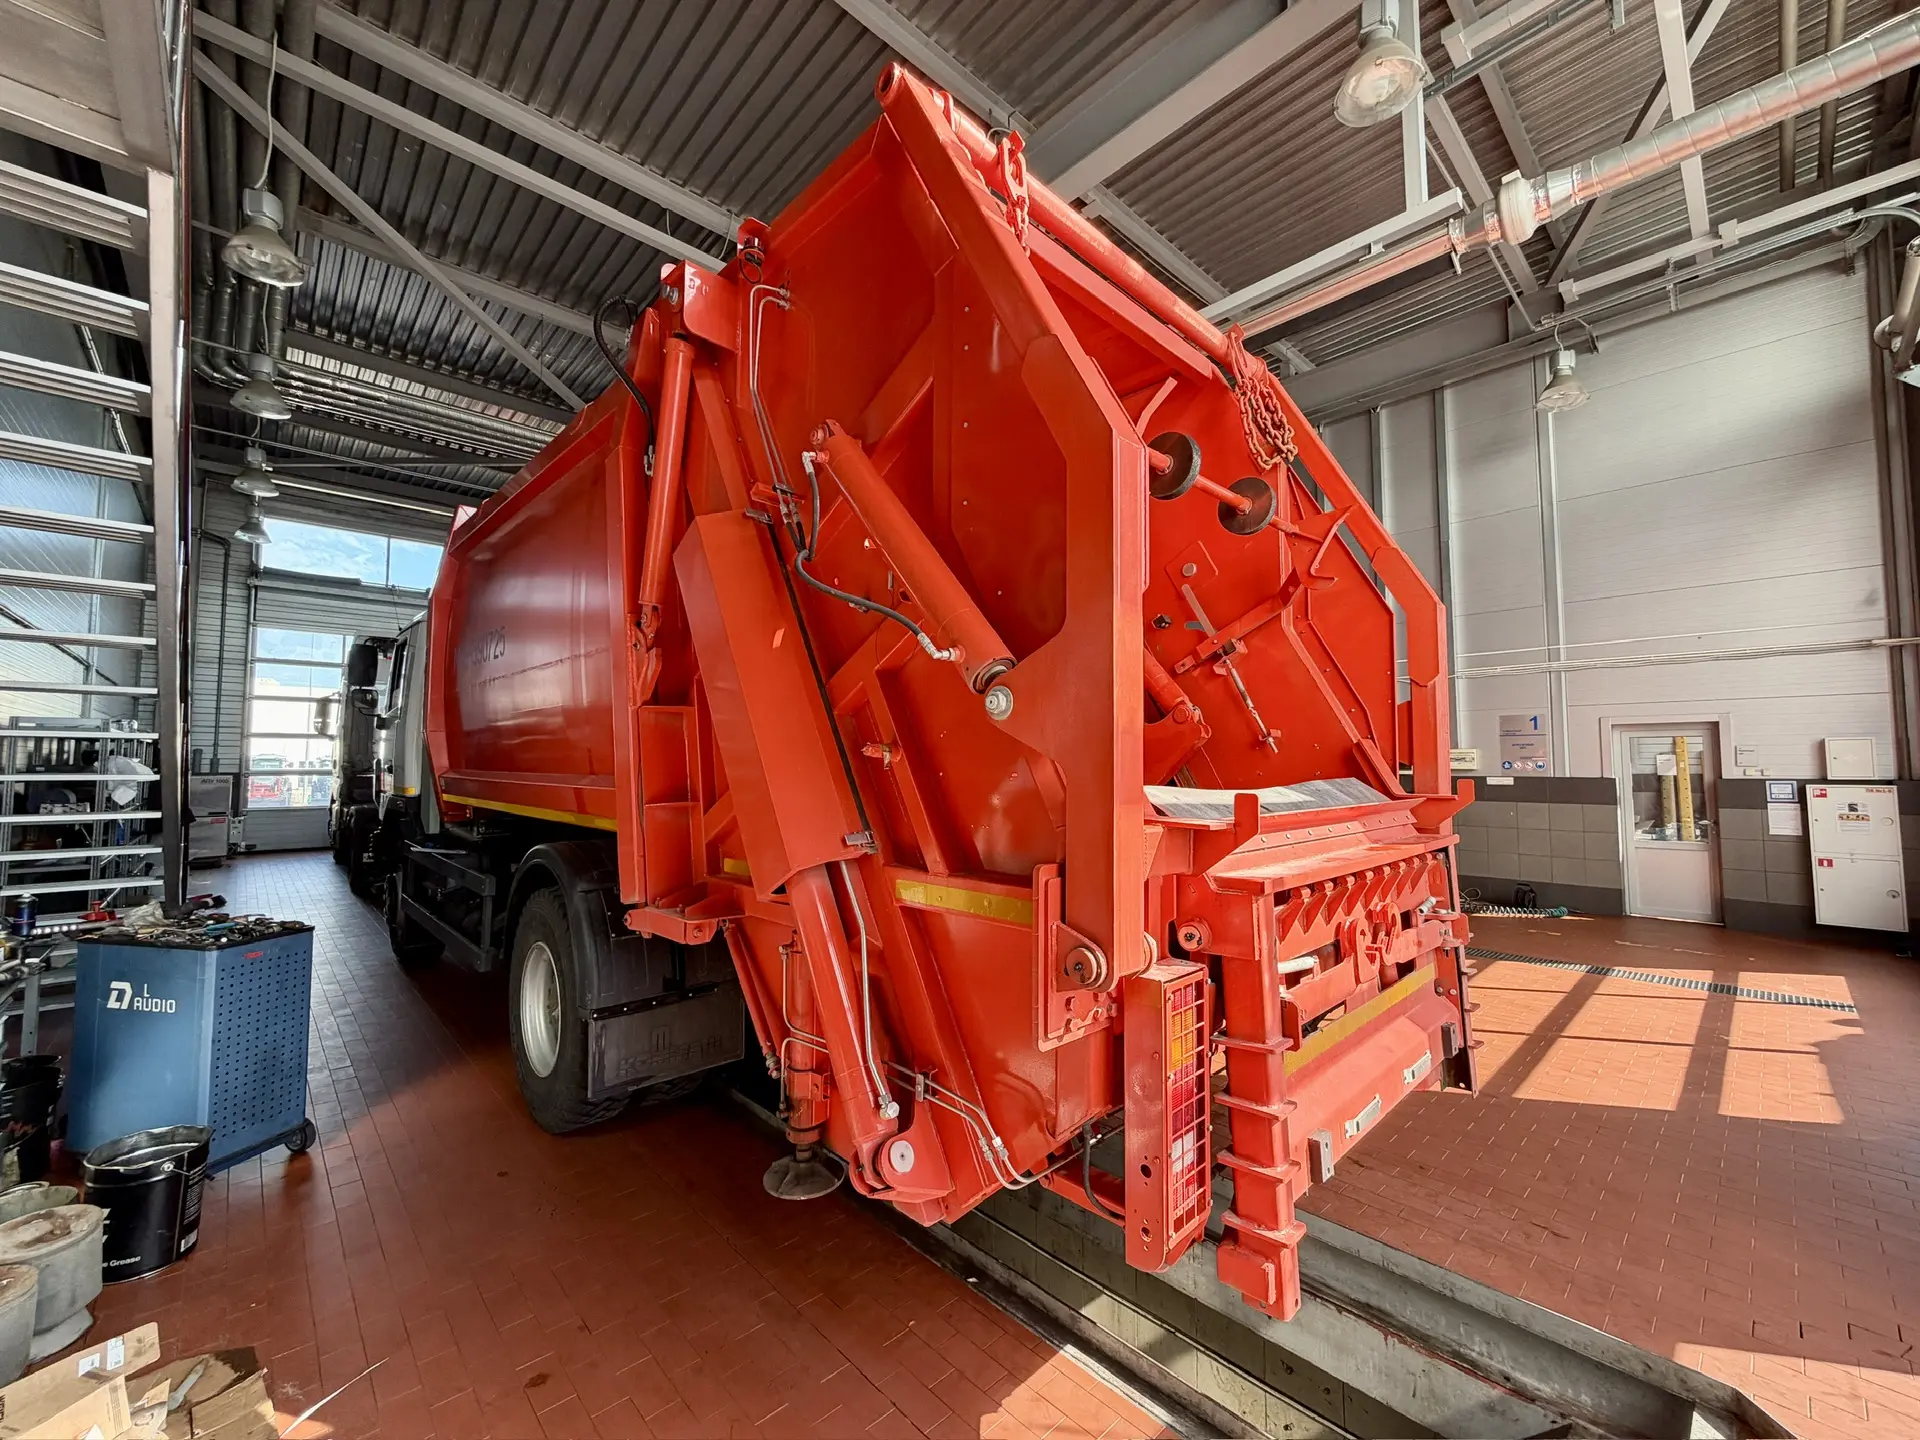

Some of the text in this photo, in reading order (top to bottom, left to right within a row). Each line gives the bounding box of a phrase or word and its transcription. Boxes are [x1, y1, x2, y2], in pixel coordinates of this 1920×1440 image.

[1528, 715, 1538, 731] 1
[133, 997, 176, 1013] AUDIO
[109, 1256, 142, 1267] Grease
